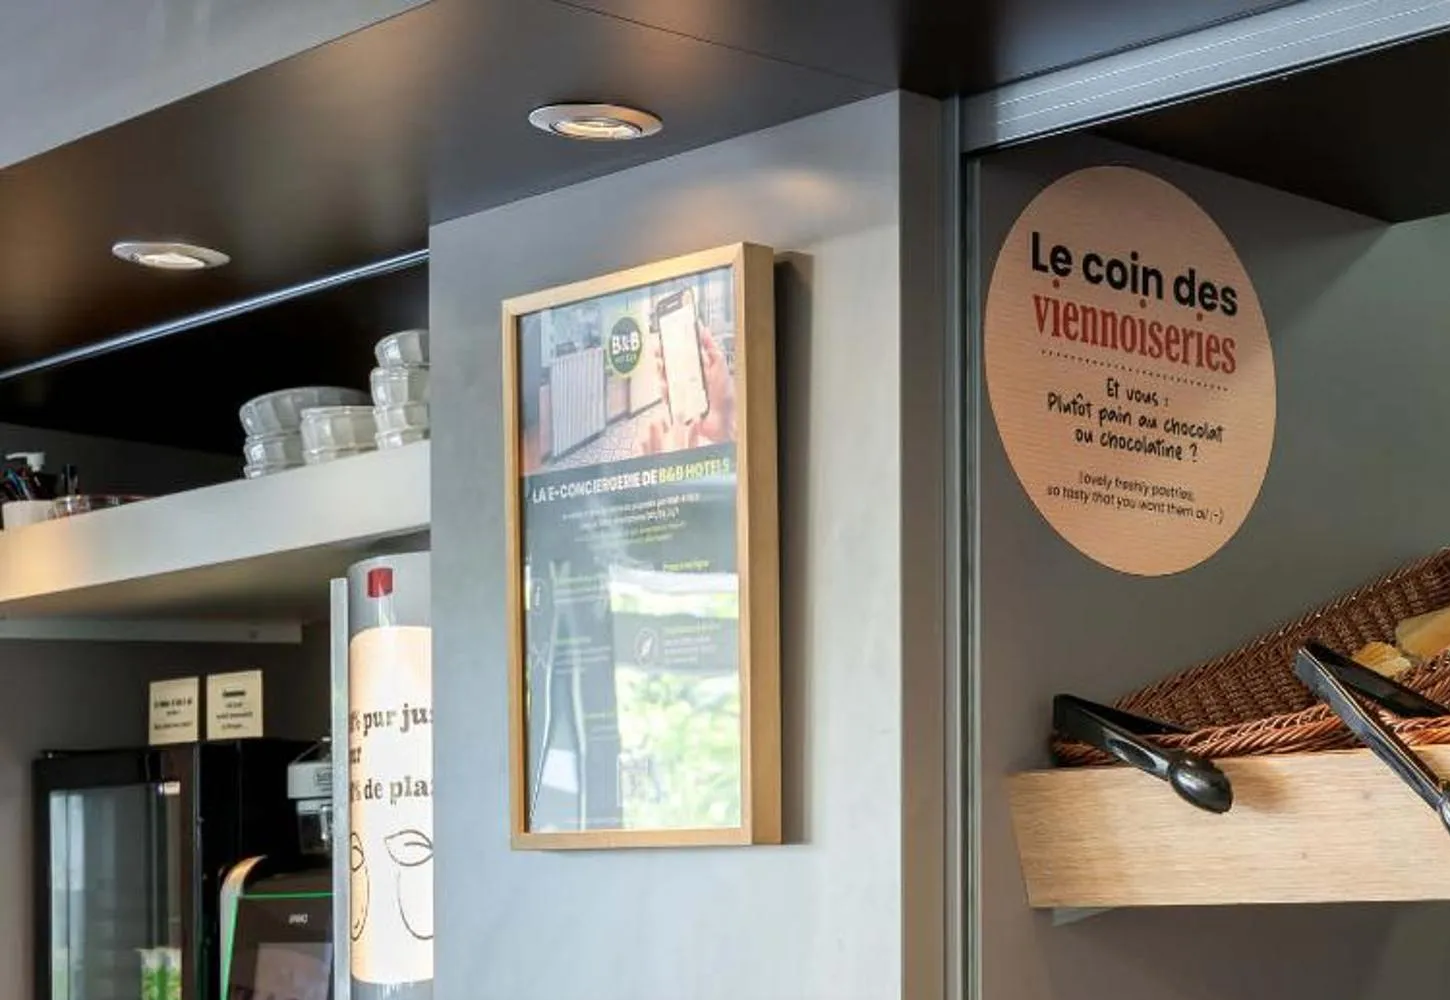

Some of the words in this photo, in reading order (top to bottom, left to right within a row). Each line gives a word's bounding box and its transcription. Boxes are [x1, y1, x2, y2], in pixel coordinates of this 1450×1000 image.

[1031, 231, 1073, 277] Le
[1082, 250, 1163, 299] coin
[1173, 266, 1239, 317] des
[1033, 279, 1238, 374] viennoiseries
[1106, 377, 1121, 400] Et
[1126, 386, 1160, 407] vous
[1047, 391, 1094, 419] Plutôt
[1098, 405, 1132, 428] pain
[1138, 415, 1158, 430] au
[1163, 417, 1225, 443] chocolat
[1075, 427, 1094, 443] ou
[1100, 430, 1183, 461] chocolatine
[1189, 442, 1199, 463] ?
[532, 487, 547, 504] LA
[642, 468, 659, 487] DE
[683, 456, 731, 480] HOTELS
[363, 709, 397, 737] pur
[364, 777, 384, 801] de
[389, 774, 435, 806] pla
